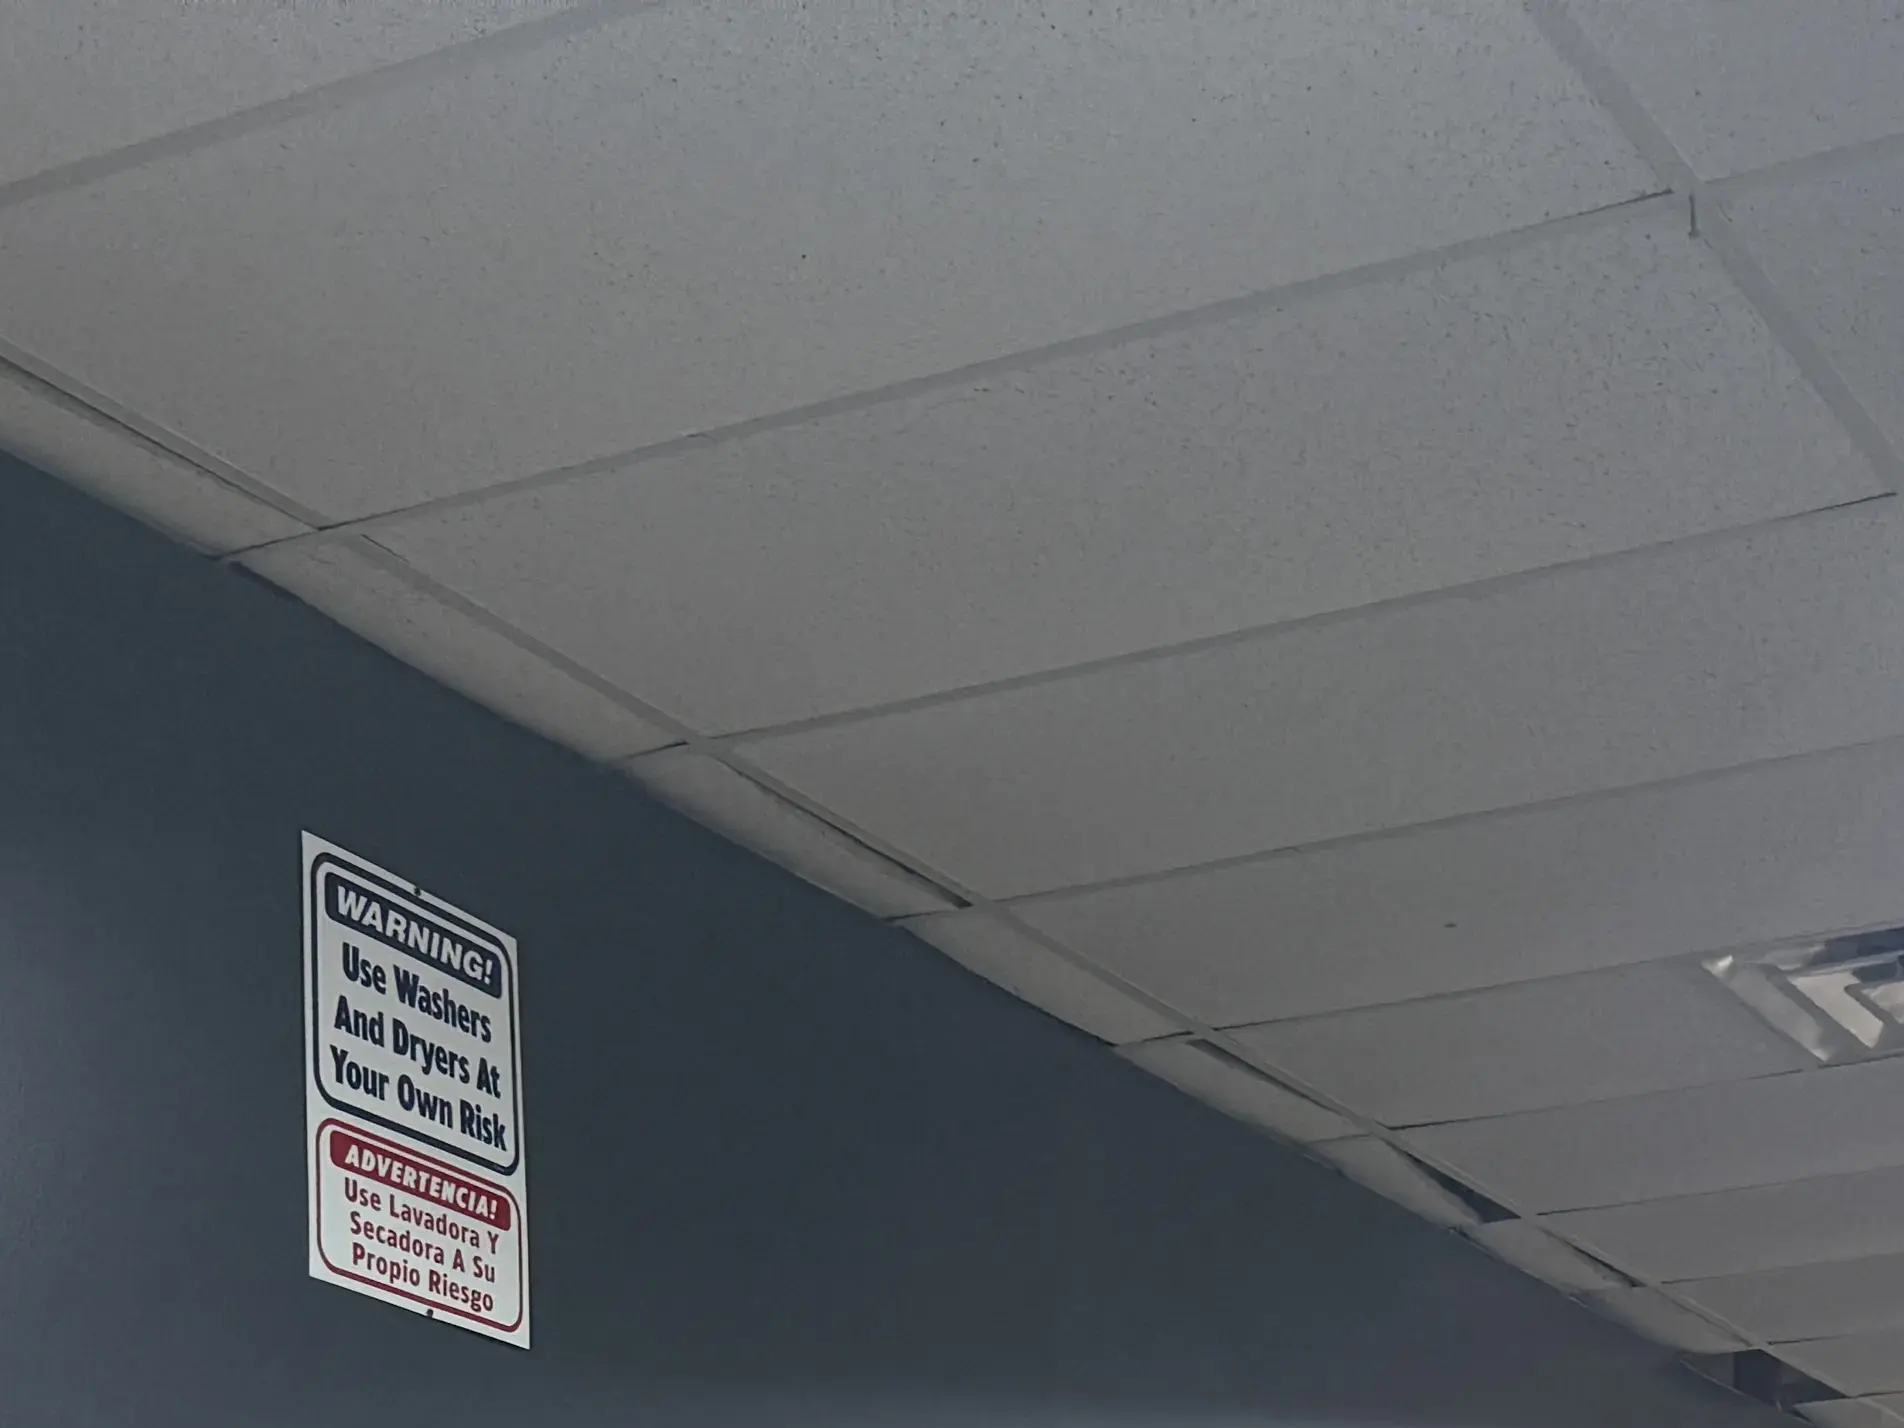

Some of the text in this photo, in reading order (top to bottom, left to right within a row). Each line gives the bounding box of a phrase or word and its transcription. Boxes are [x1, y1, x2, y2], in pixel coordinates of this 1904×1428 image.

[338, 885, 493, 985] WARNING!
[343, 941, 491, 1043] Use Washers
[334, 994, 501, 1099] And Dryers At
[329, 1044, 507, 1152] Your Own Risk
[344, 1144, 498, 1219] ADVERTENCIA!
[344, 1176, 499, 1254] Use Lavadora Y
[350, 1211, 495, 1283] Secadora A Su
[353, 1242, 494, 1312] Propio Riesgo
